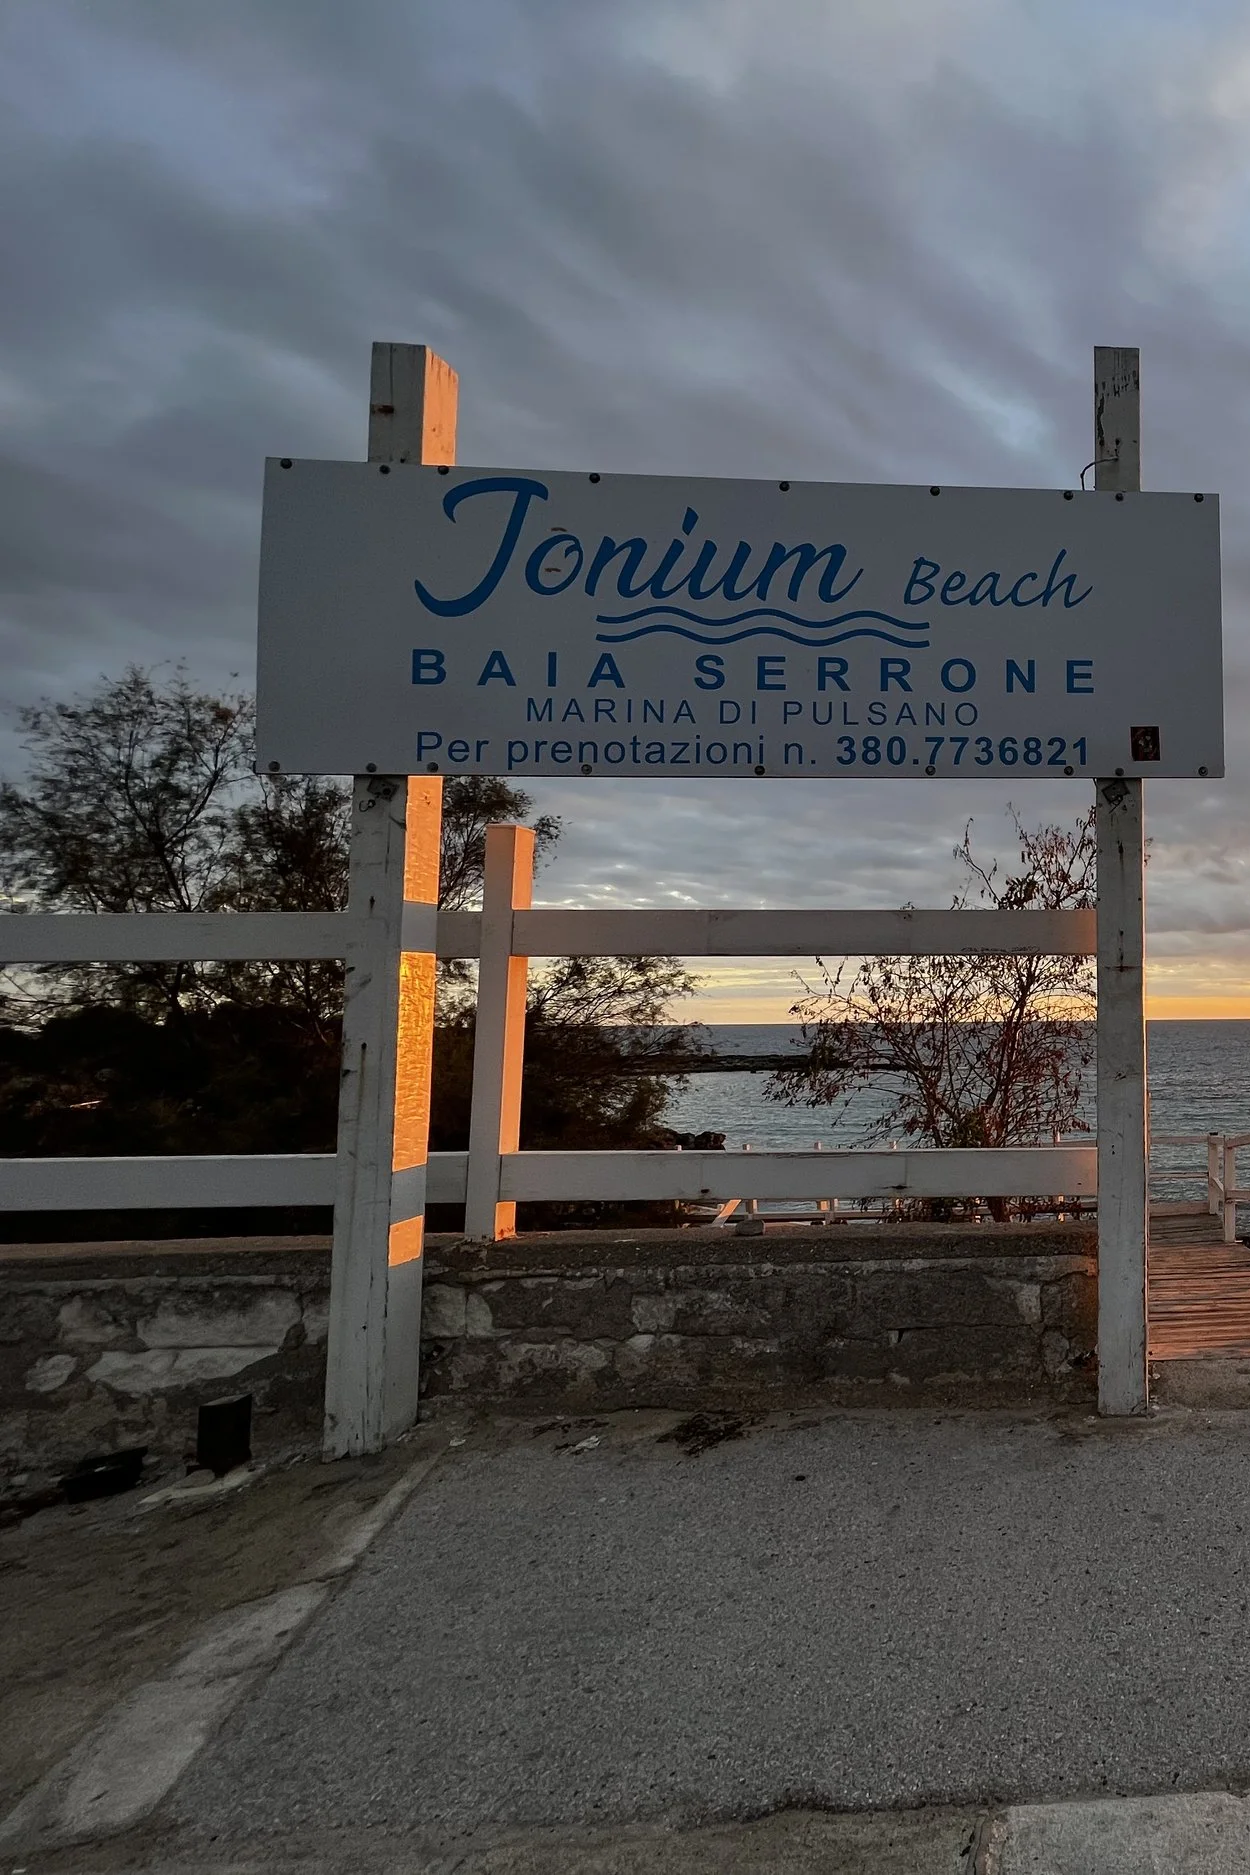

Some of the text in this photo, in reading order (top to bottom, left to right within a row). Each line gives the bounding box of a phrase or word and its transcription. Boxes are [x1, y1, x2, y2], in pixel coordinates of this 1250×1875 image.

[414, 477, 1094, 618] Jonium Beach
[410, 648, 1096, 696] BAIA SERRONE
[526, 697, 979, 727] MARINA DI PULSANO
[416, 731, 1089, 771] Per prenotazioni n. 380.7736821
